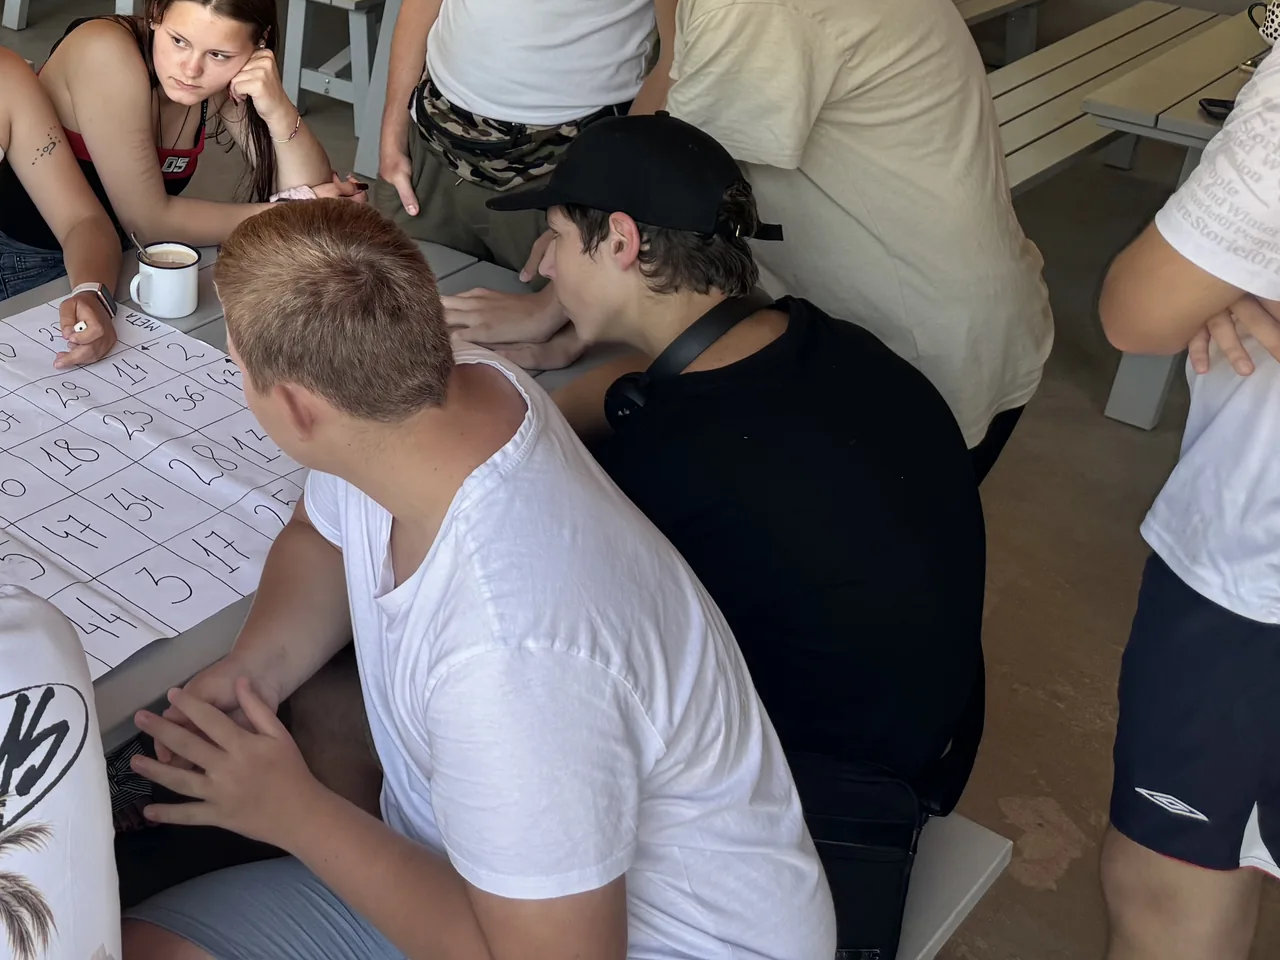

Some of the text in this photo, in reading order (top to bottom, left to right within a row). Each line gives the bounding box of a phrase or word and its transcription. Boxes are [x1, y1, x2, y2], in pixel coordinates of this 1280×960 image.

[161, 156, 190, 173] 05
[125, 312, 161, 332] META
[166, 342, 205, 361] 2
[112, 358, 148, 386] 14
[45, 381, 91, 409] 29
[164, 384, 205, 412] 36
[102, 409, 154, 441] 23
[39, 438, 100, 477] 18
[168, 444, 238, 486] 28
[42, 514, 108, 550] 47
[191, 530, 251, 574] 17
[134, 566, 193, 605] 3
